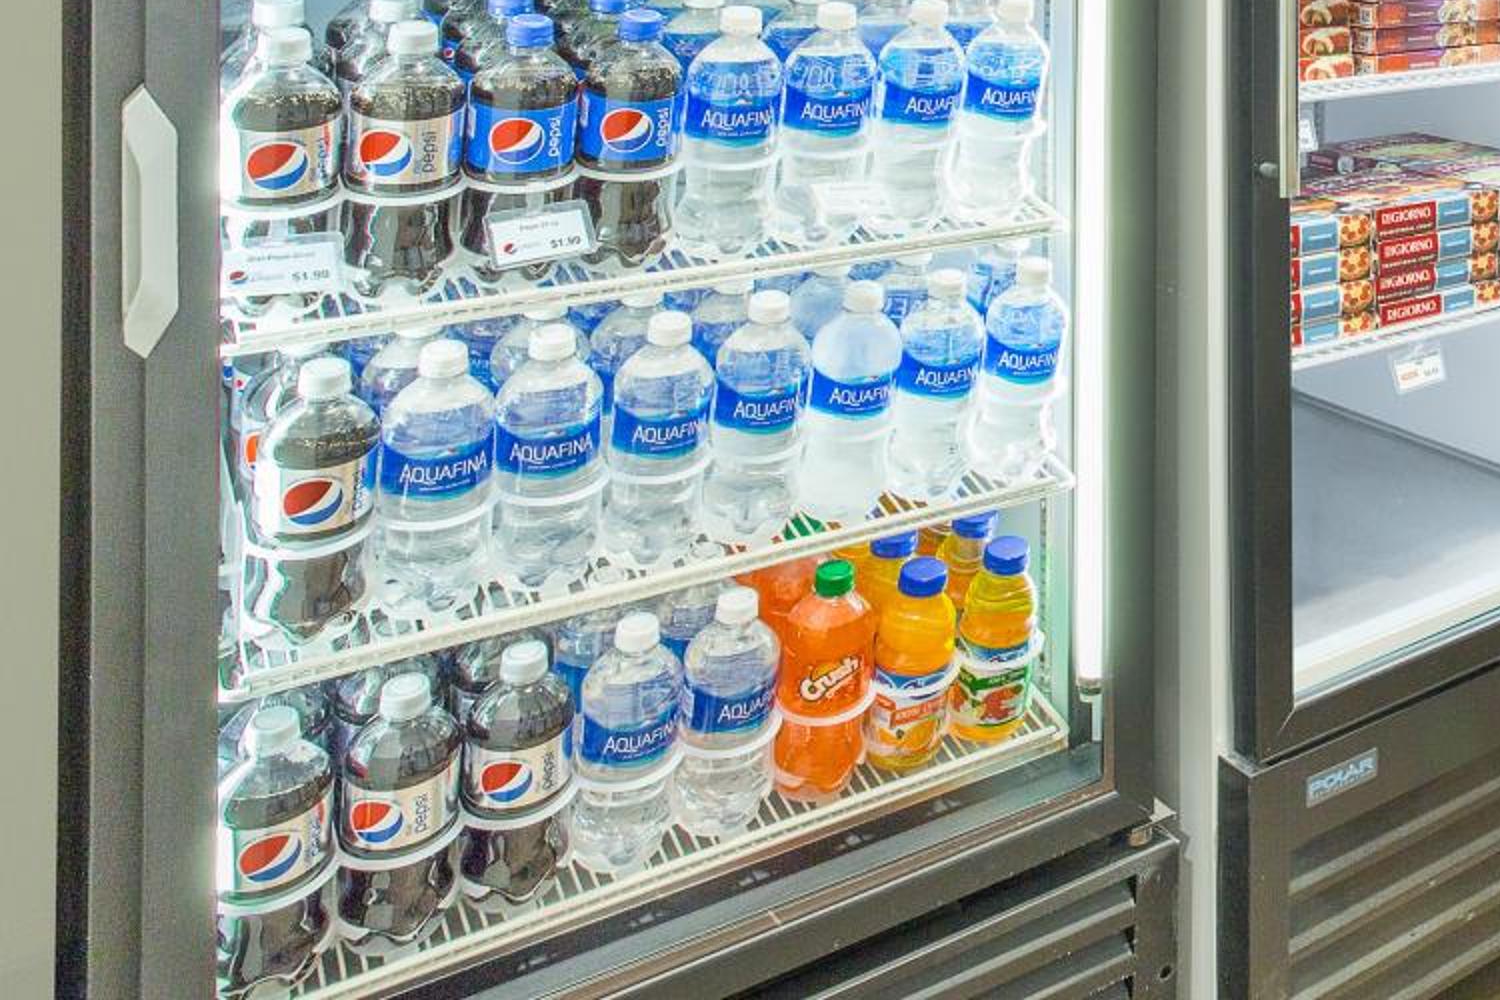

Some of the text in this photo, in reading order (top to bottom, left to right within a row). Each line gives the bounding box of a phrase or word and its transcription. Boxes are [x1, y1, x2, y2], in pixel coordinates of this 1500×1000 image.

[547, 116, 562, 158] pepsi
[656, 107, 670, 148] pepsi
[422, 130, 438, 174] pepsi
[550, 235, 581, 249] $1.99
[999, 349, 1057, 371] AQUAFIN
[733, 396, 801, 421] AQUAFIN
[509, 431, 594, 465] AQUAFINA
[631, 420, 702, 445] AQUAFIN
[399, 450, 488, 486] AQUAFINA
[800, 655, 862, 701] Crush
[1311, 756, 1374, 792] POLAR
